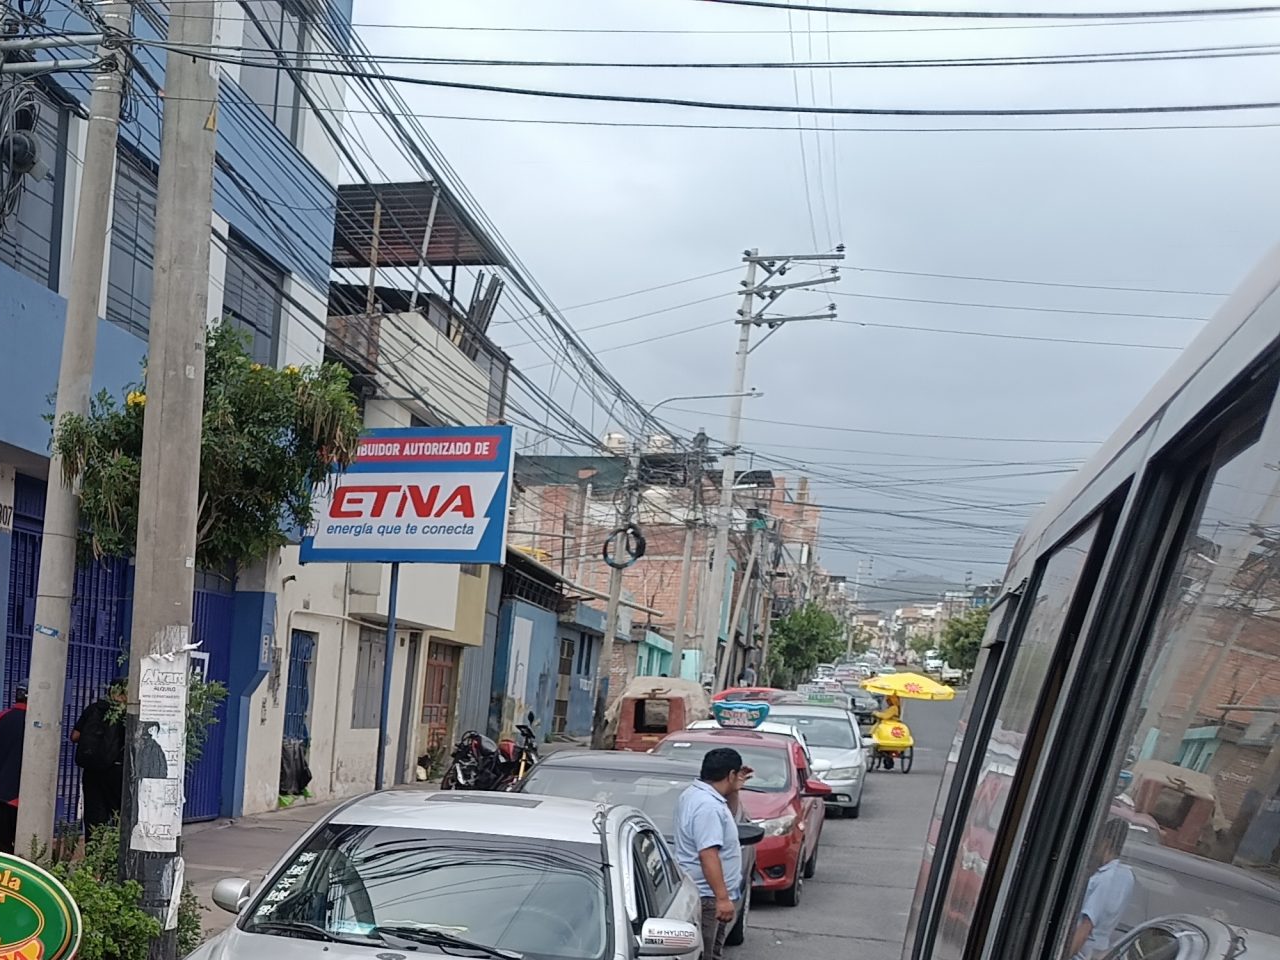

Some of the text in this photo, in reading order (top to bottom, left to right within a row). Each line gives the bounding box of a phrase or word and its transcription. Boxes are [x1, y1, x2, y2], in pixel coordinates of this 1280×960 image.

[357, 441, 490, 457] IBUIDOR AUTORIZADO DE
[328, 485, 475, 518] ETNA
[377, 524, 402, 537] que
[405, 523, 417, 535] te
[421, 523, 474, 535] conecta
